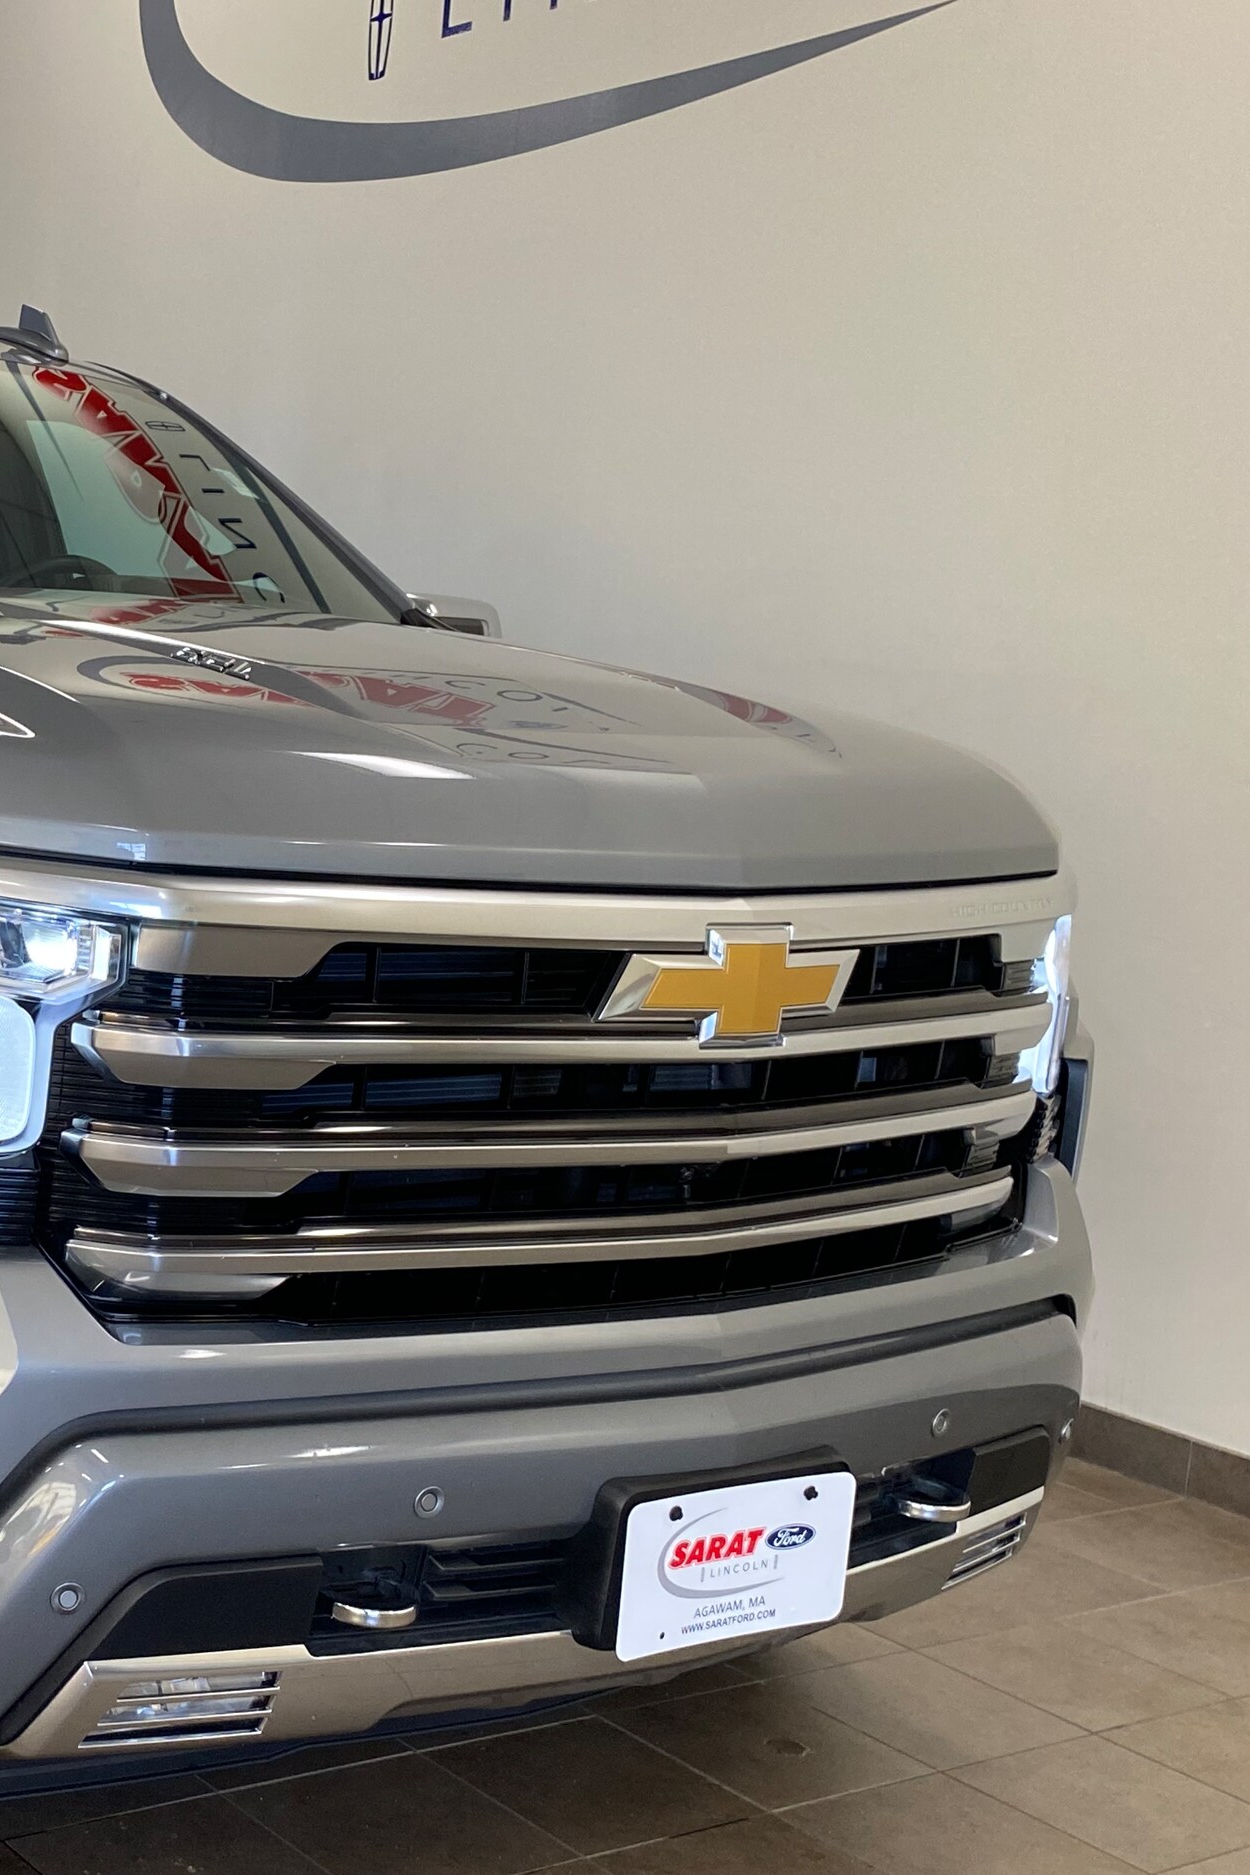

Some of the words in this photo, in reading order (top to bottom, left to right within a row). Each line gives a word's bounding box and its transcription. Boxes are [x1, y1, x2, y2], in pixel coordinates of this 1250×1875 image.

[669, 1528, 765, 1569] SARAT
[771, 1526, 807, 1548] Ford
[709, 1559, 768, 1578] LINCOLN
[694, 1599, 745, 1619] AGAWAM,
[748, 1595, 766, 1608] MA
[681, 1609, 776, 1635] WWW.SARATFORD.COM
